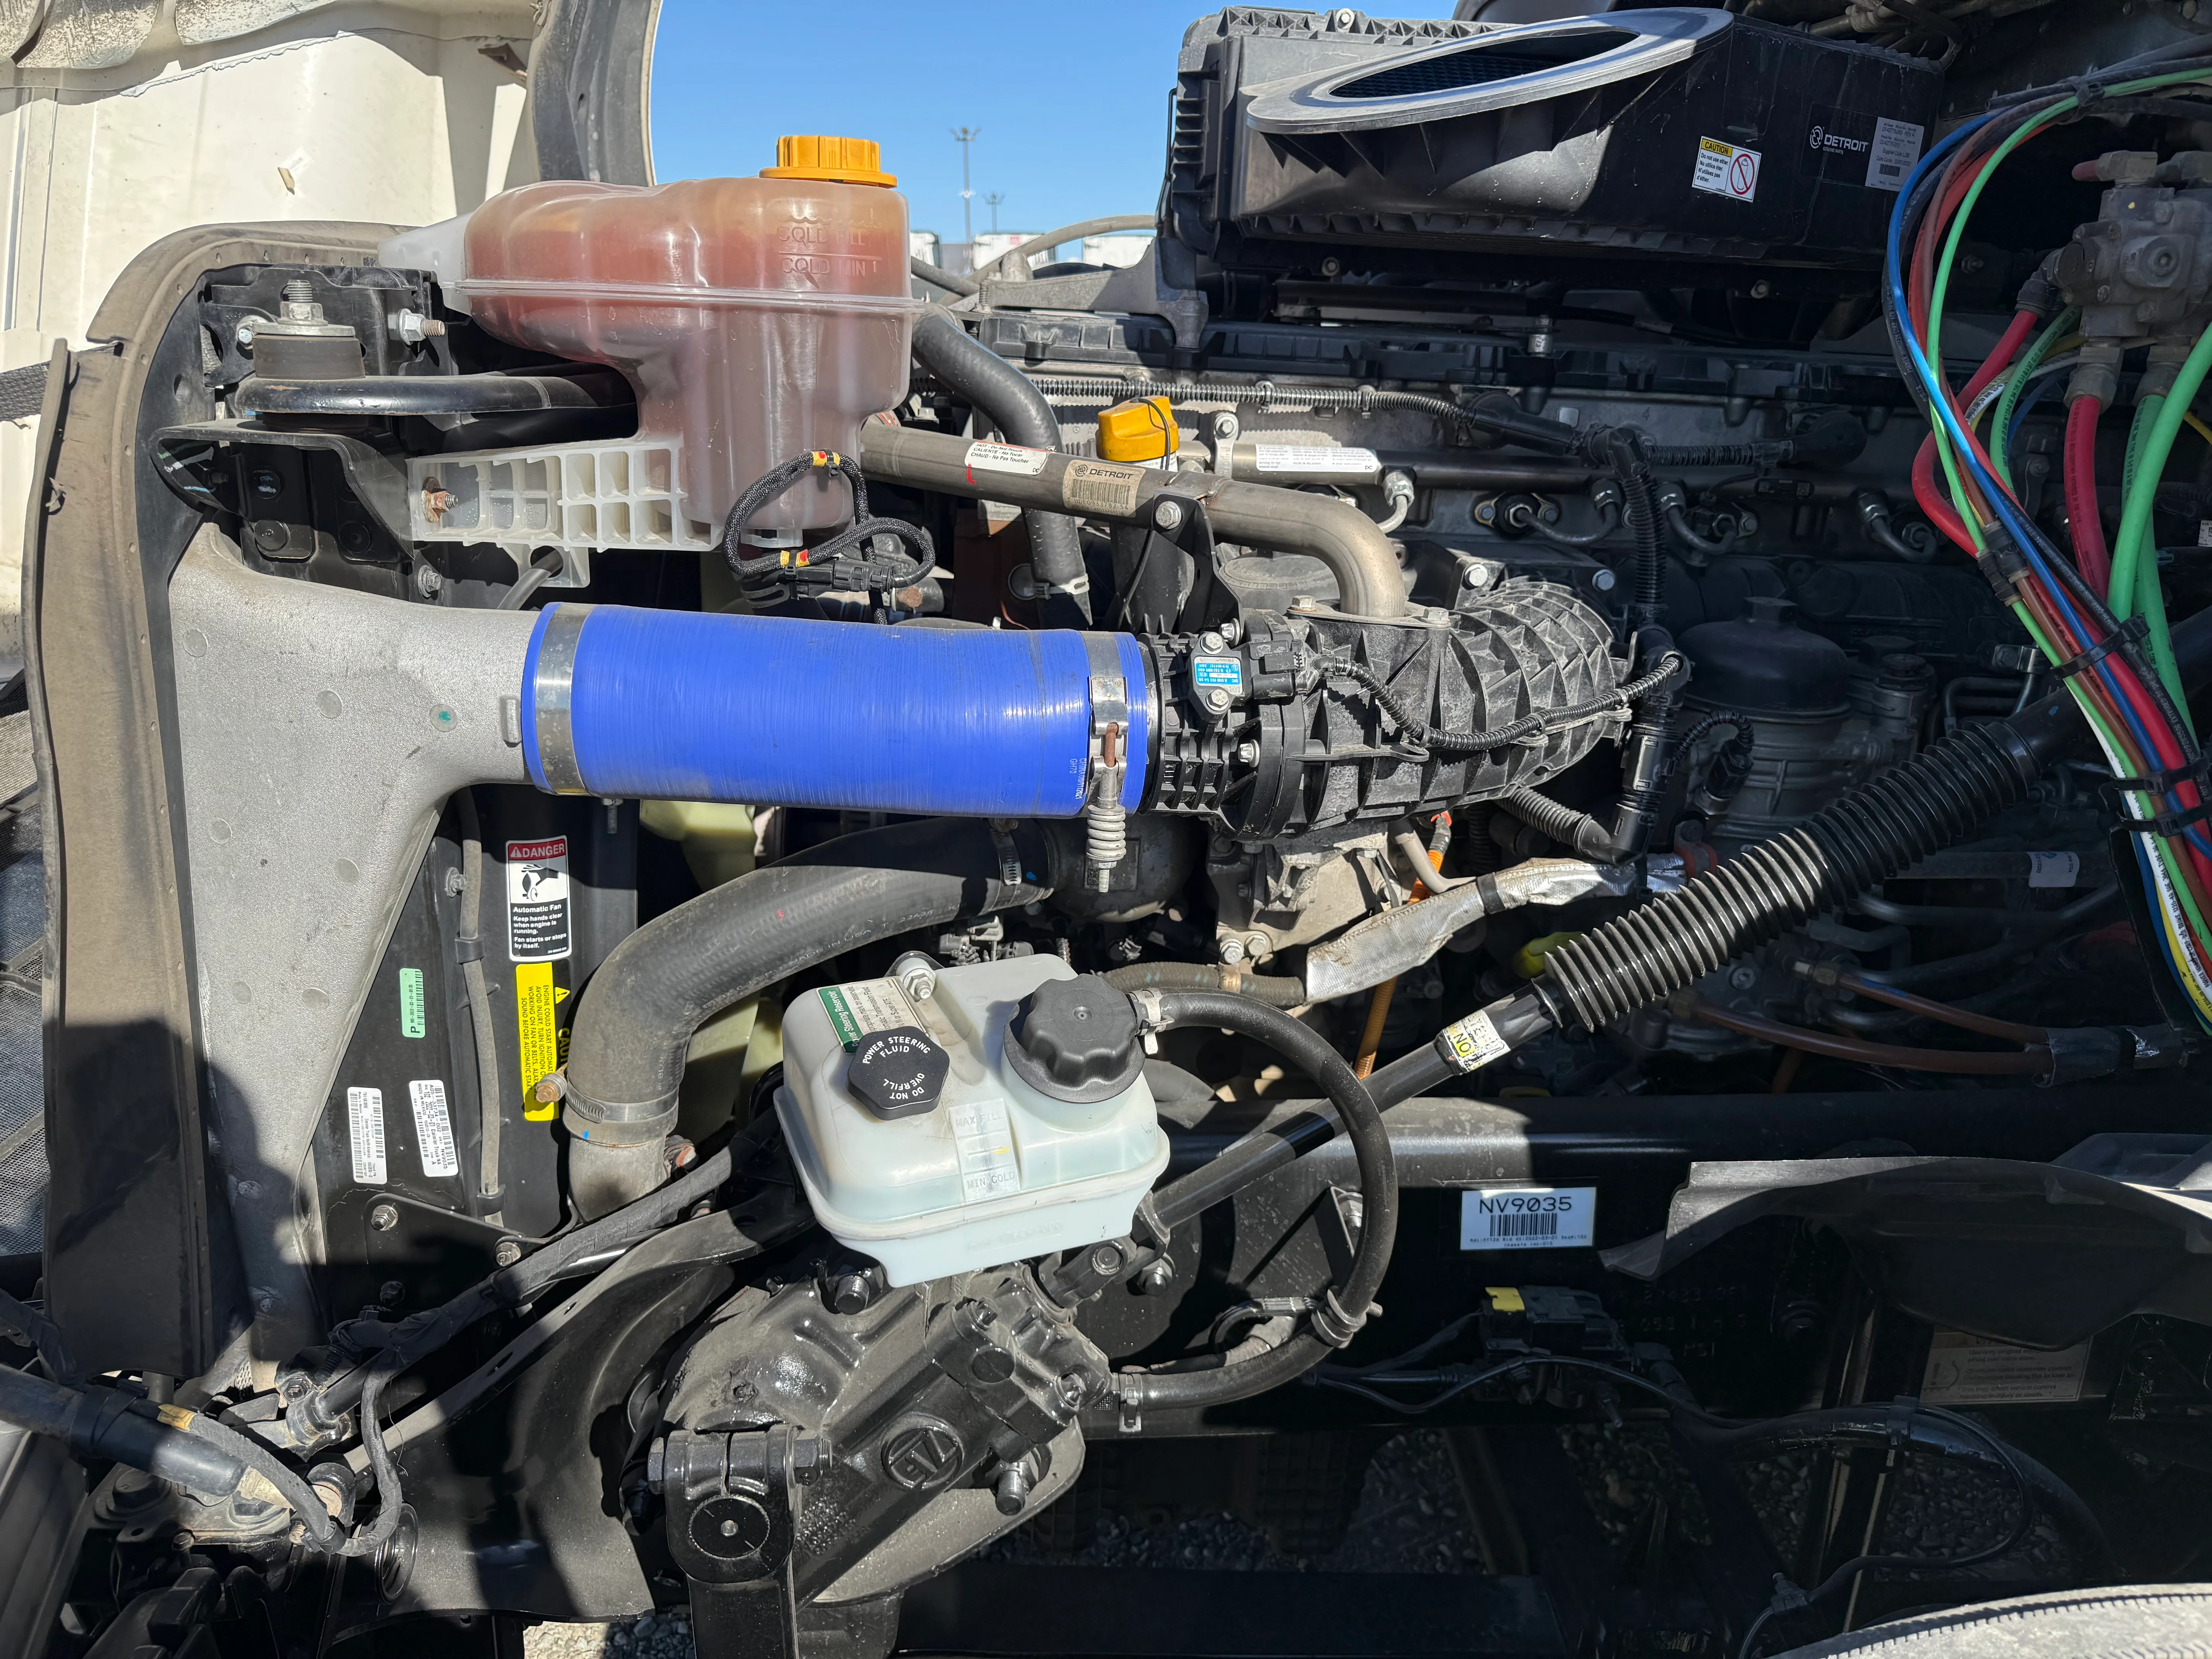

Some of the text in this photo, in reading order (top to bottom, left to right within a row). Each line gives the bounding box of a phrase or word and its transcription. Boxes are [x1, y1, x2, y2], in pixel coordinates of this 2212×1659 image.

[1705, 141, 1729, 155] CAUTION
[1824, 134, 1869, 152] DETROIT
[777, 226, 866, 246] COLD FILL
[782, 258, 866, 276] COLD MIN
[1089, 469, 1133, 479] DETROIT
[2159, 697, 2179, 724] EXTRUDED
[1070, 759, 1078, 773] GH70
[522, 843, 565, 858] DANGER
[2155, 854, 2164, 867] TYPE
[789, 947, 824, 966] MADE
[828, 939, 840, 949] IN
[828, 991, 845, 1013] Reservoir
[858, 1005, 866, 1015] mark
[861, 984, 884, 1018] Transmission Fluid
[883, 996, 893, 1007] ATF.
[886, 1003, 900, 1017] Super
[530, 1017, 536, 1026] ON
[838, 1009, 853, 1032] Steering
[531, 1040, 537, 1048] OR
[862, 1041, 884, 1064] POWER
[880, 1045, 910, 1057] FLUID
[888, 1036, 931, 1054] STEERING
[883, 1073, 925, 1091] OVERFILL
[912, 1087, 925, 1096] DO
[425, 1101, 436, 1127] 2022-03-01
[955, 1112, 1003, 1127] MAX FILL
[967, 1171, 1015, 1189] MIN COLD
[1479, 1196, 1572, 1214] NV9035
